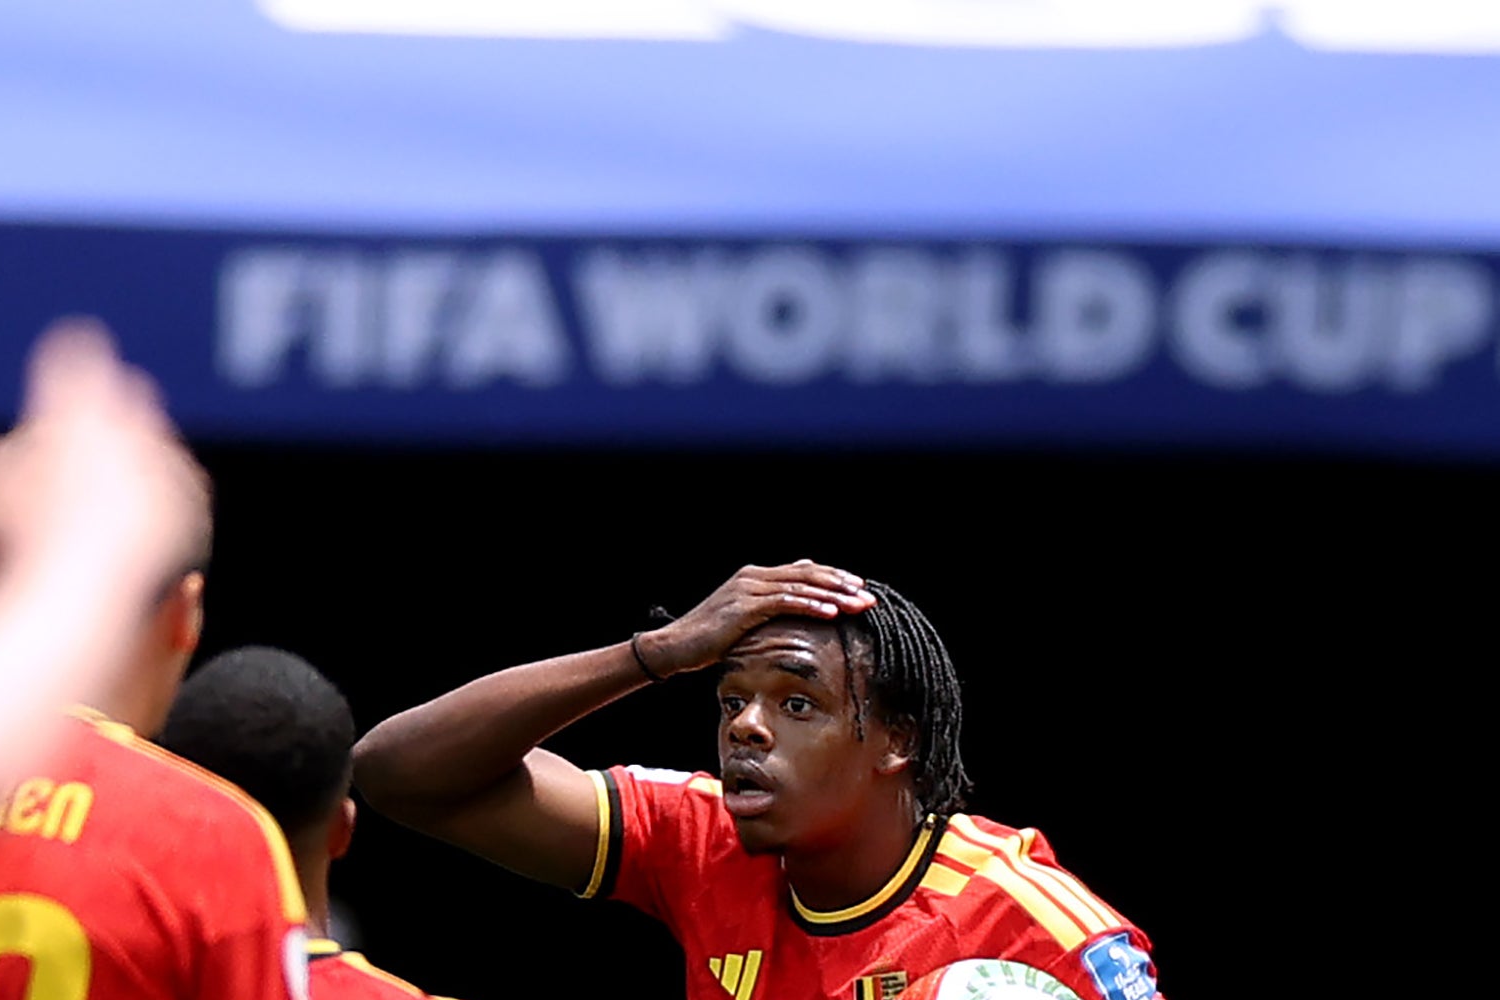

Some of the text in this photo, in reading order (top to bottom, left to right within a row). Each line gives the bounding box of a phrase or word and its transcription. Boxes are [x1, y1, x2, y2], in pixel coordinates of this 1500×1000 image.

[218, 247, 1493, 390] FIFA WORLD CUP
